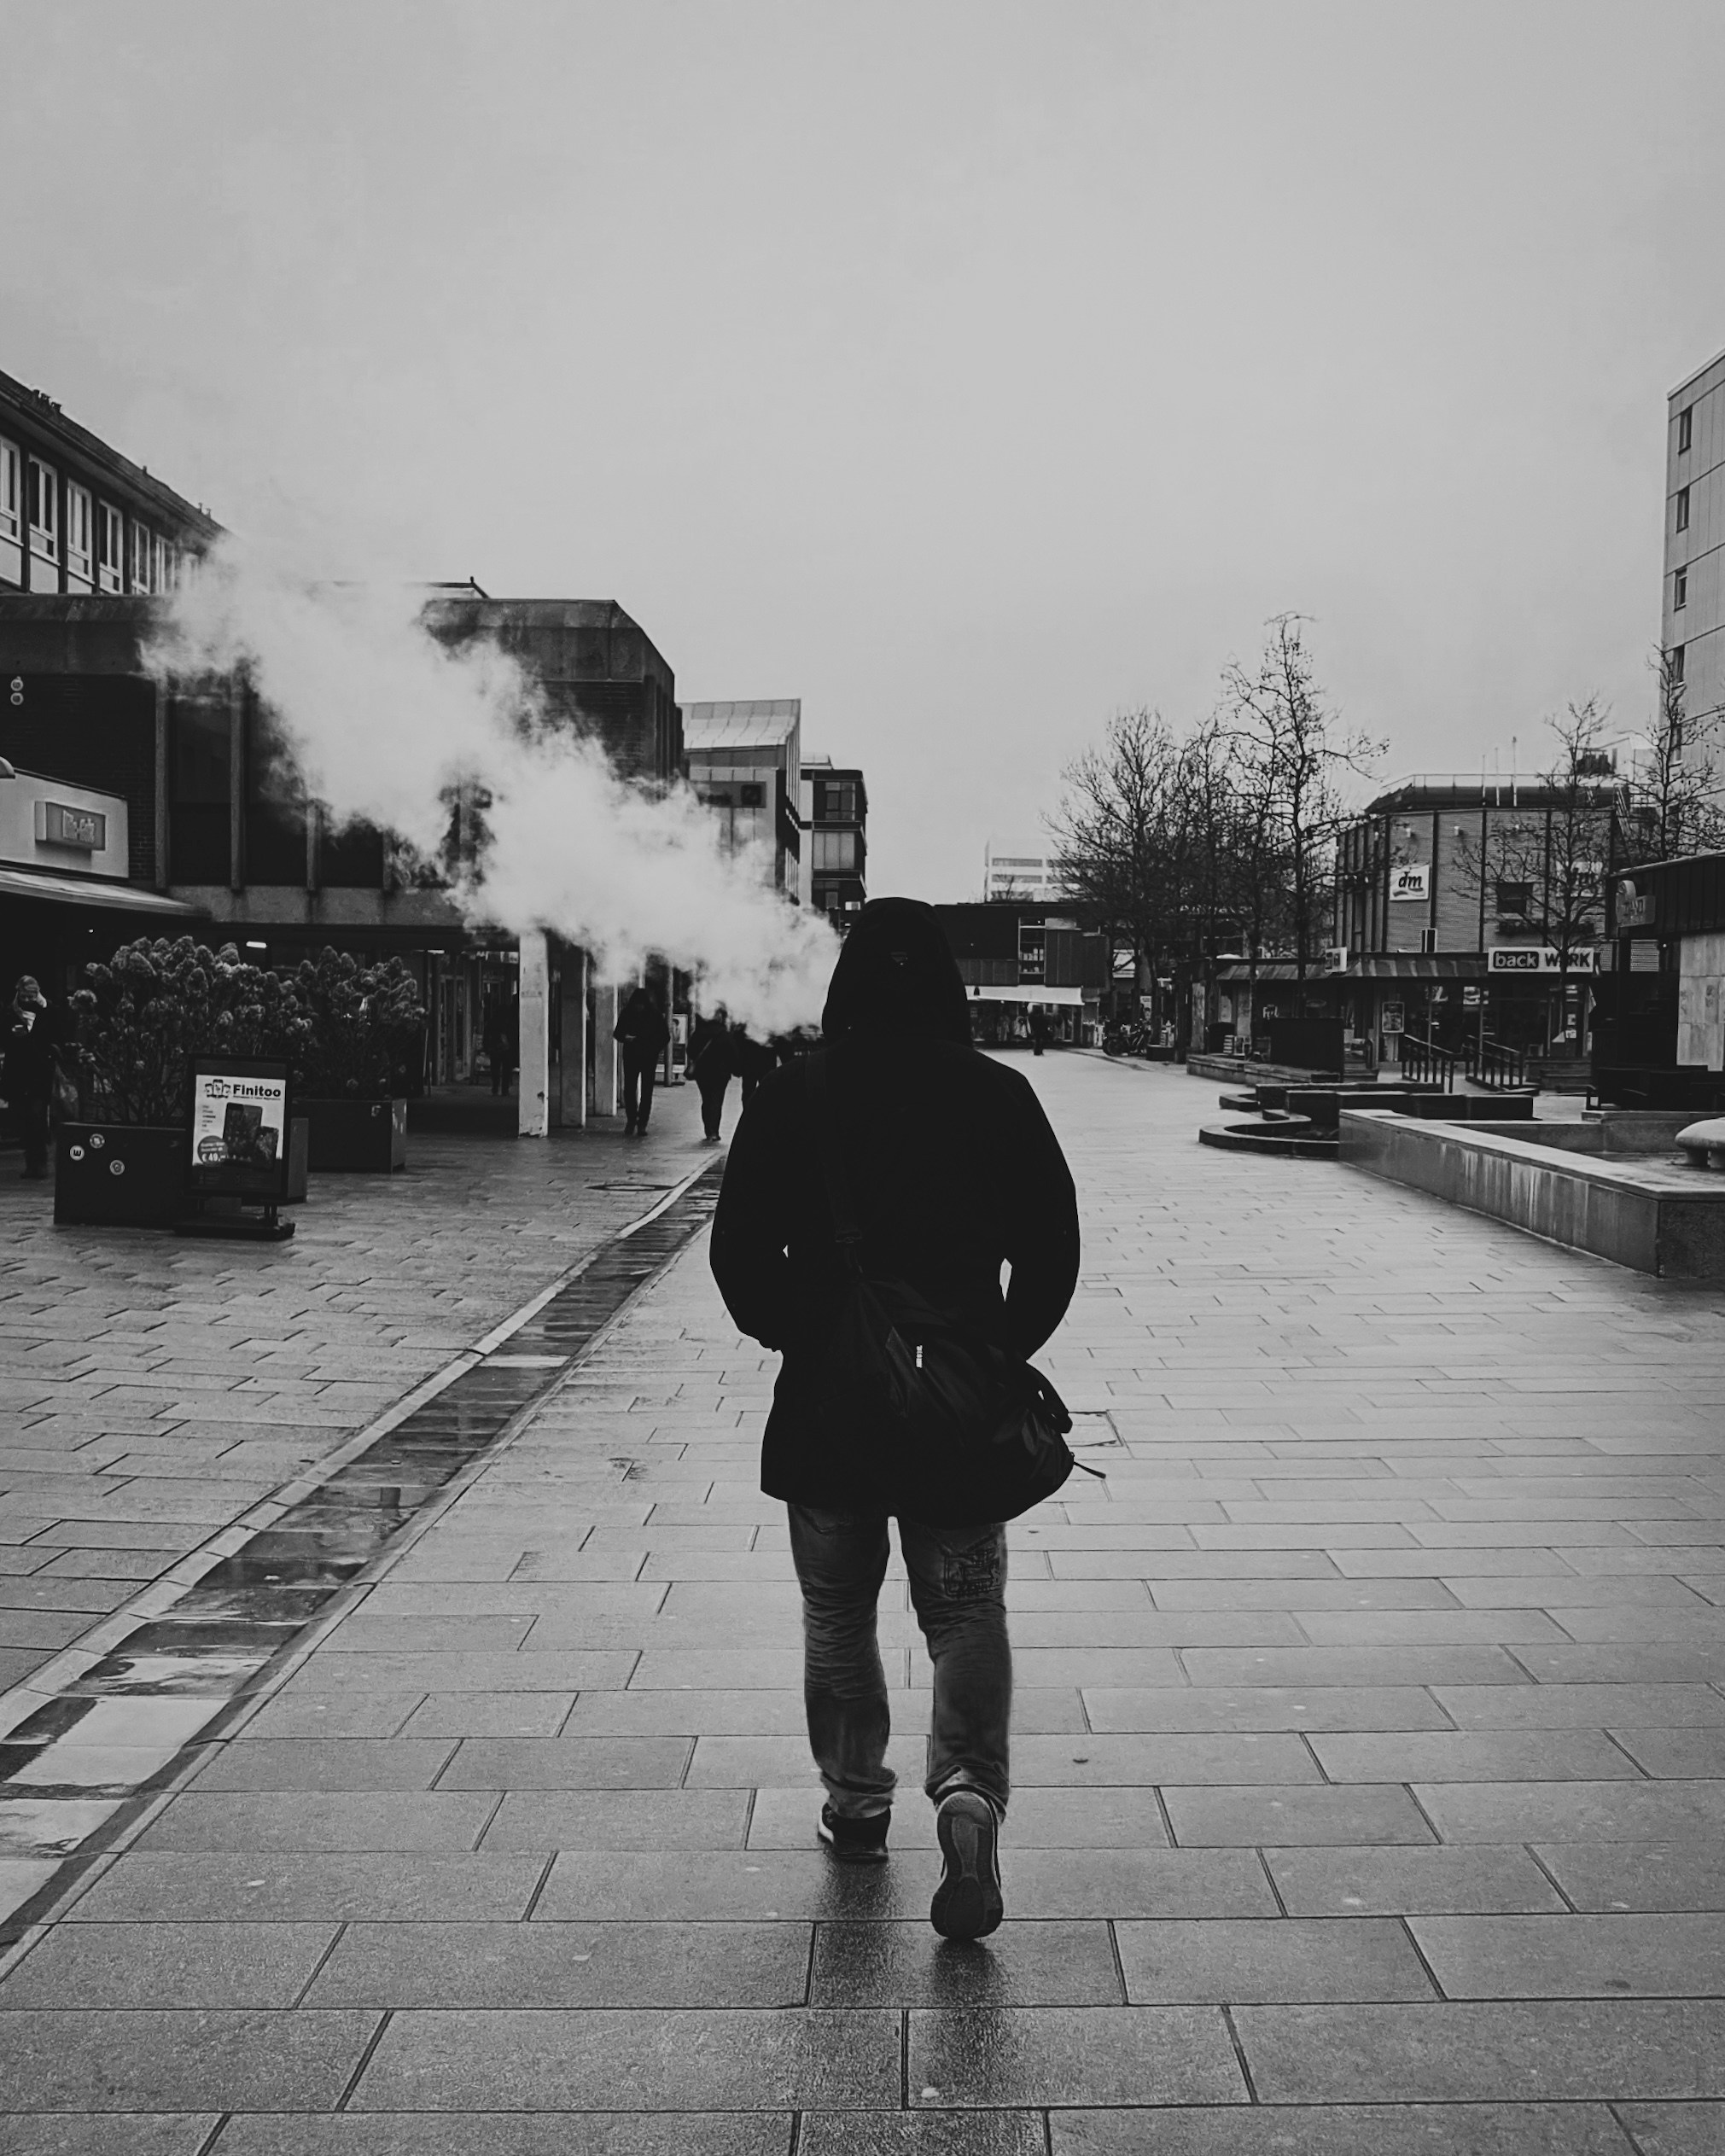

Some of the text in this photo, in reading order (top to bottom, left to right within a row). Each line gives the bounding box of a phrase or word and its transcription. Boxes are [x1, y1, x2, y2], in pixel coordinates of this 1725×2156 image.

[1398, 871, 1422, 888] dm
[1495, 952, 1590, 968] back WRK
[233, 1084, 281, 1098] Finitoo
